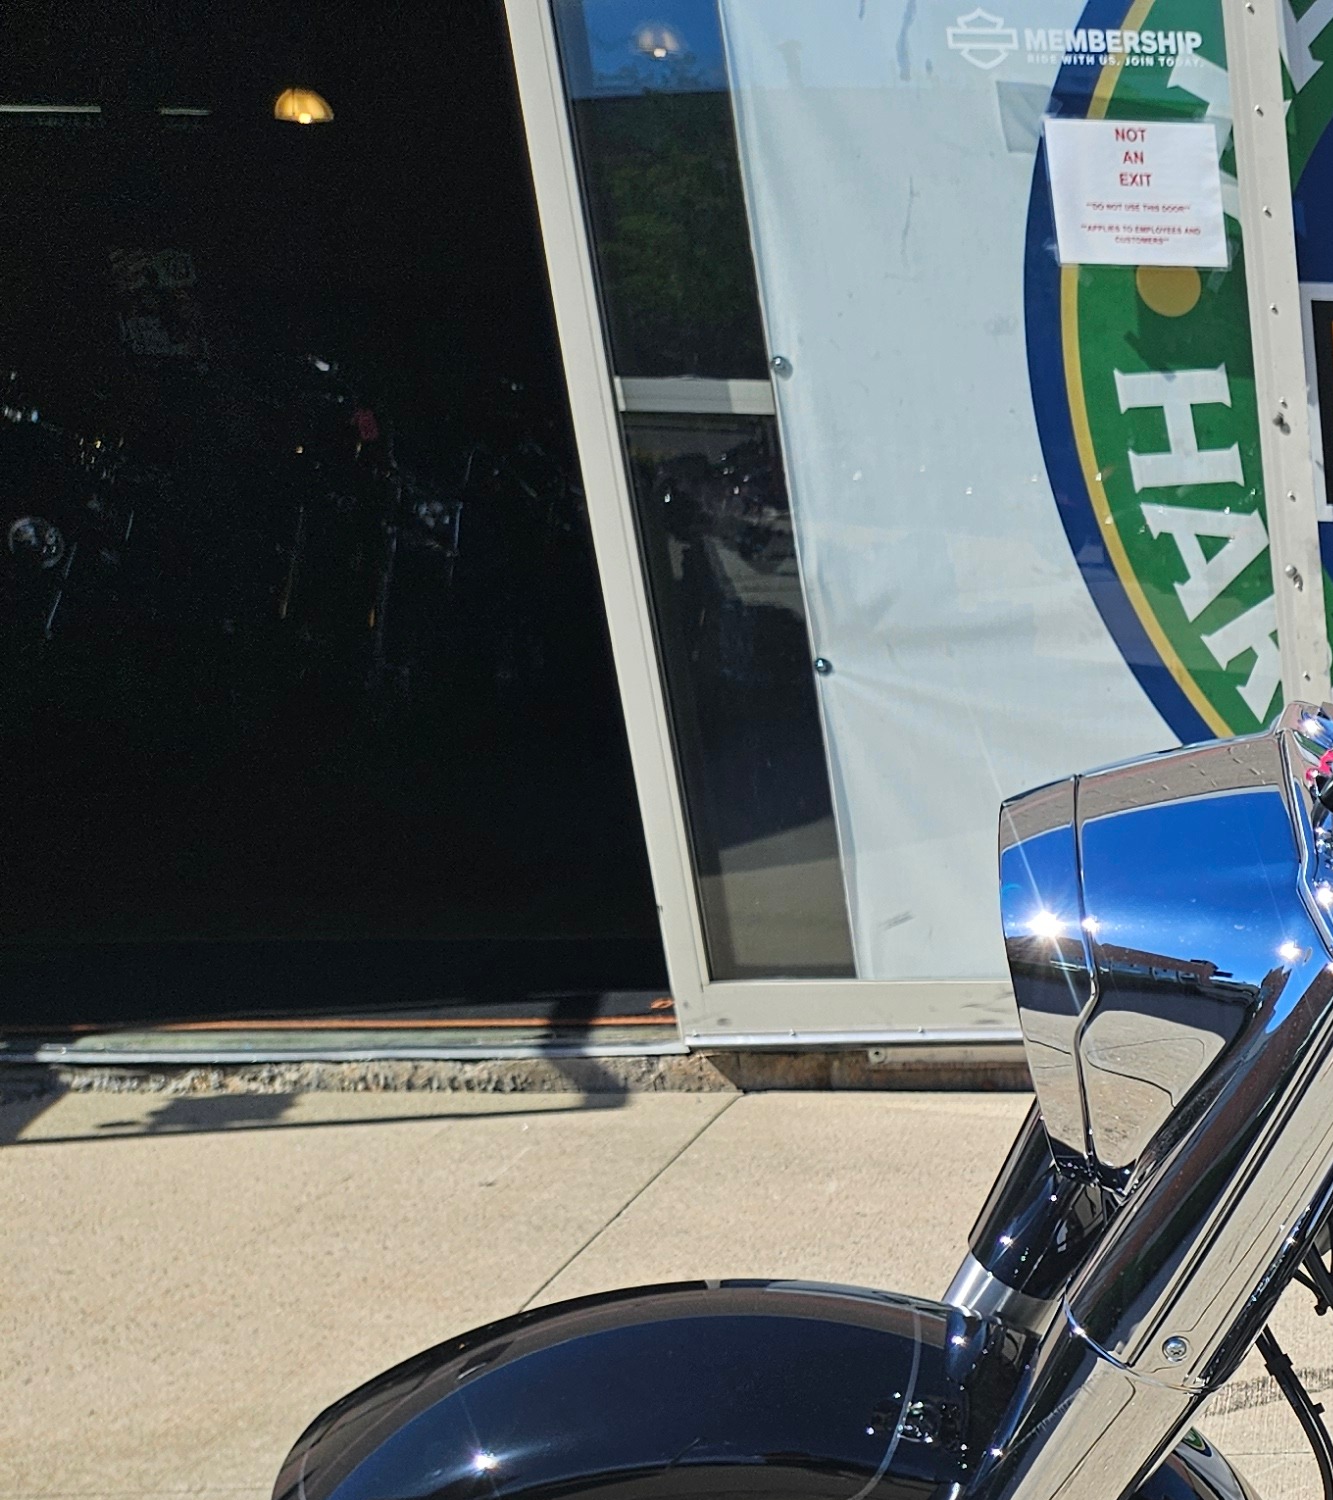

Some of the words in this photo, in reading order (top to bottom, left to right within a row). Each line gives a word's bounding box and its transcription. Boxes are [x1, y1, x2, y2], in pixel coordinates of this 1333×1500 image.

[1024, 28, 1203, 55] MEMBERSHIP
[1027, 54, 1057, 65] RIDE
[1062, 55, 1095, 66] WITH
[1125, 55, 1154, 67] JOIN
[1115, 127, 1147, 142] NOT
[1123, 151, 1144, 165] AN
[1119, 173, 1152, 187] EXIT
[1106, 203, 1122, 211] NOT
[1124, 204, 1140, 212] USE
[1122, 225, 1133, 233] TO
[1135, 225, 1182, 235] EMPLOYEES
[1184, 227, 1201, 236] AND
